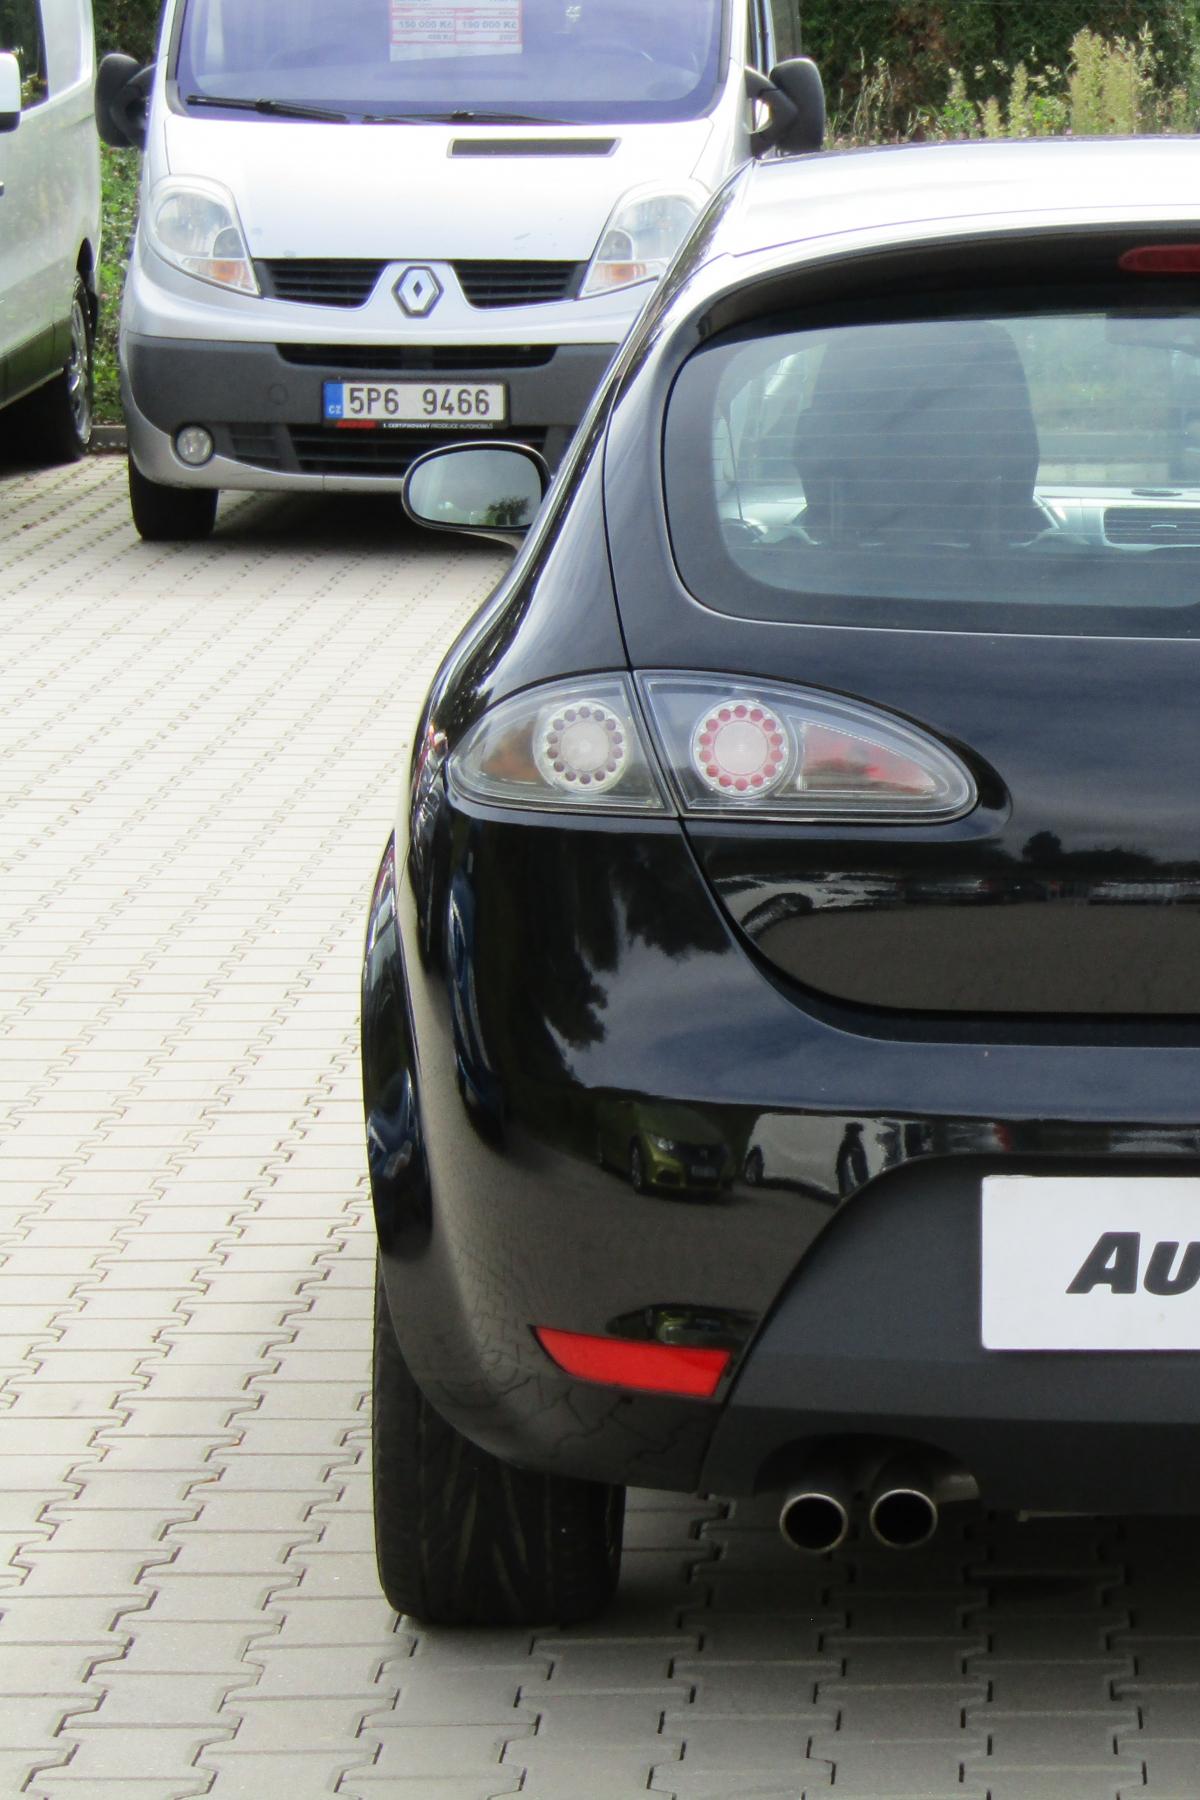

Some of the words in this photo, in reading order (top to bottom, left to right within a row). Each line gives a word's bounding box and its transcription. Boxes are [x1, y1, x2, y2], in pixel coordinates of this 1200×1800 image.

[328, 404, 342, 415] CZ
[349, 387, 400, 415] 5P6
[422, 388, 490, 416] 9466
